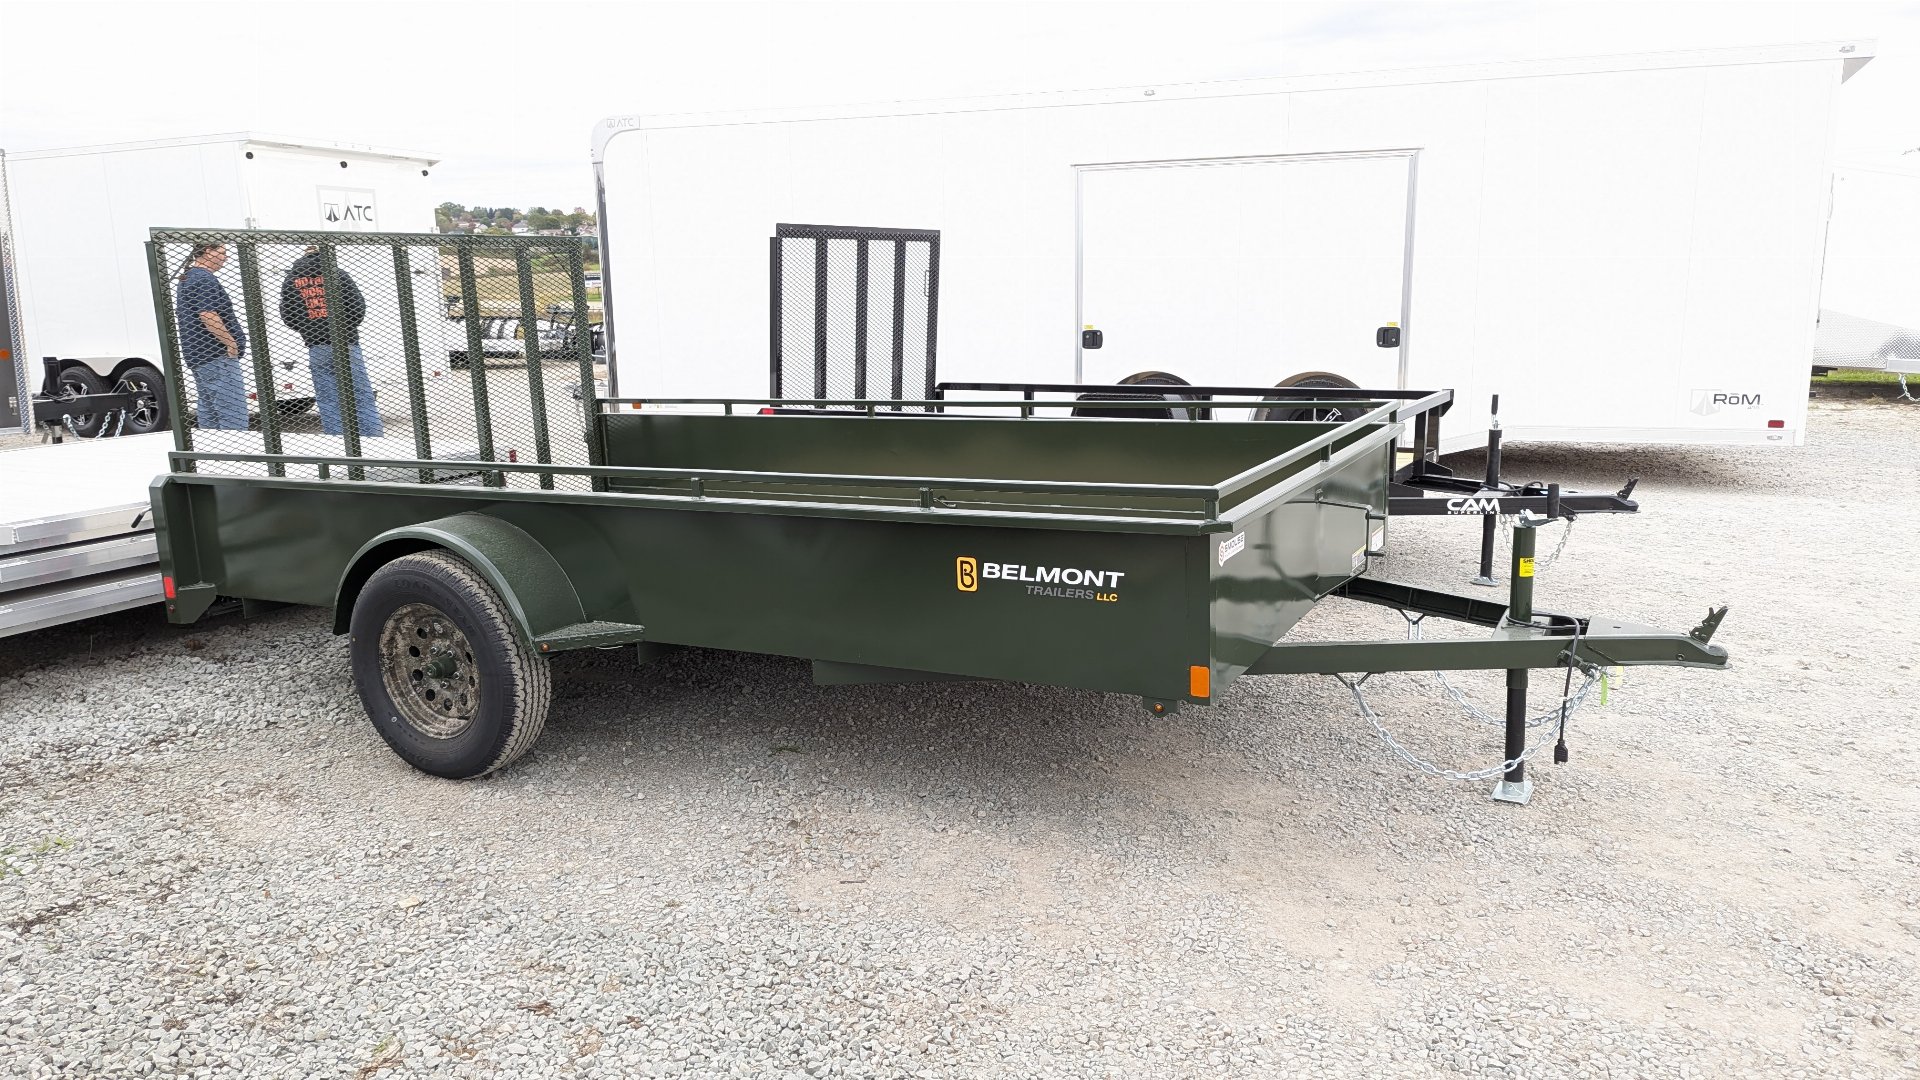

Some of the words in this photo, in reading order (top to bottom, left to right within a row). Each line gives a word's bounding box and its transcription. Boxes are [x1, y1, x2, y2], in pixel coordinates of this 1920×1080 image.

[616, 117, 634, 128] ATC
[343, 204, 373, 222] ATC
[1446, 498, 1501, 512] CAM
[982, 562, 1125, 588] BELMONT
[1025, 584, 1095, 600] TRAILERS
[1096, 592, 1118, 602] LLC
